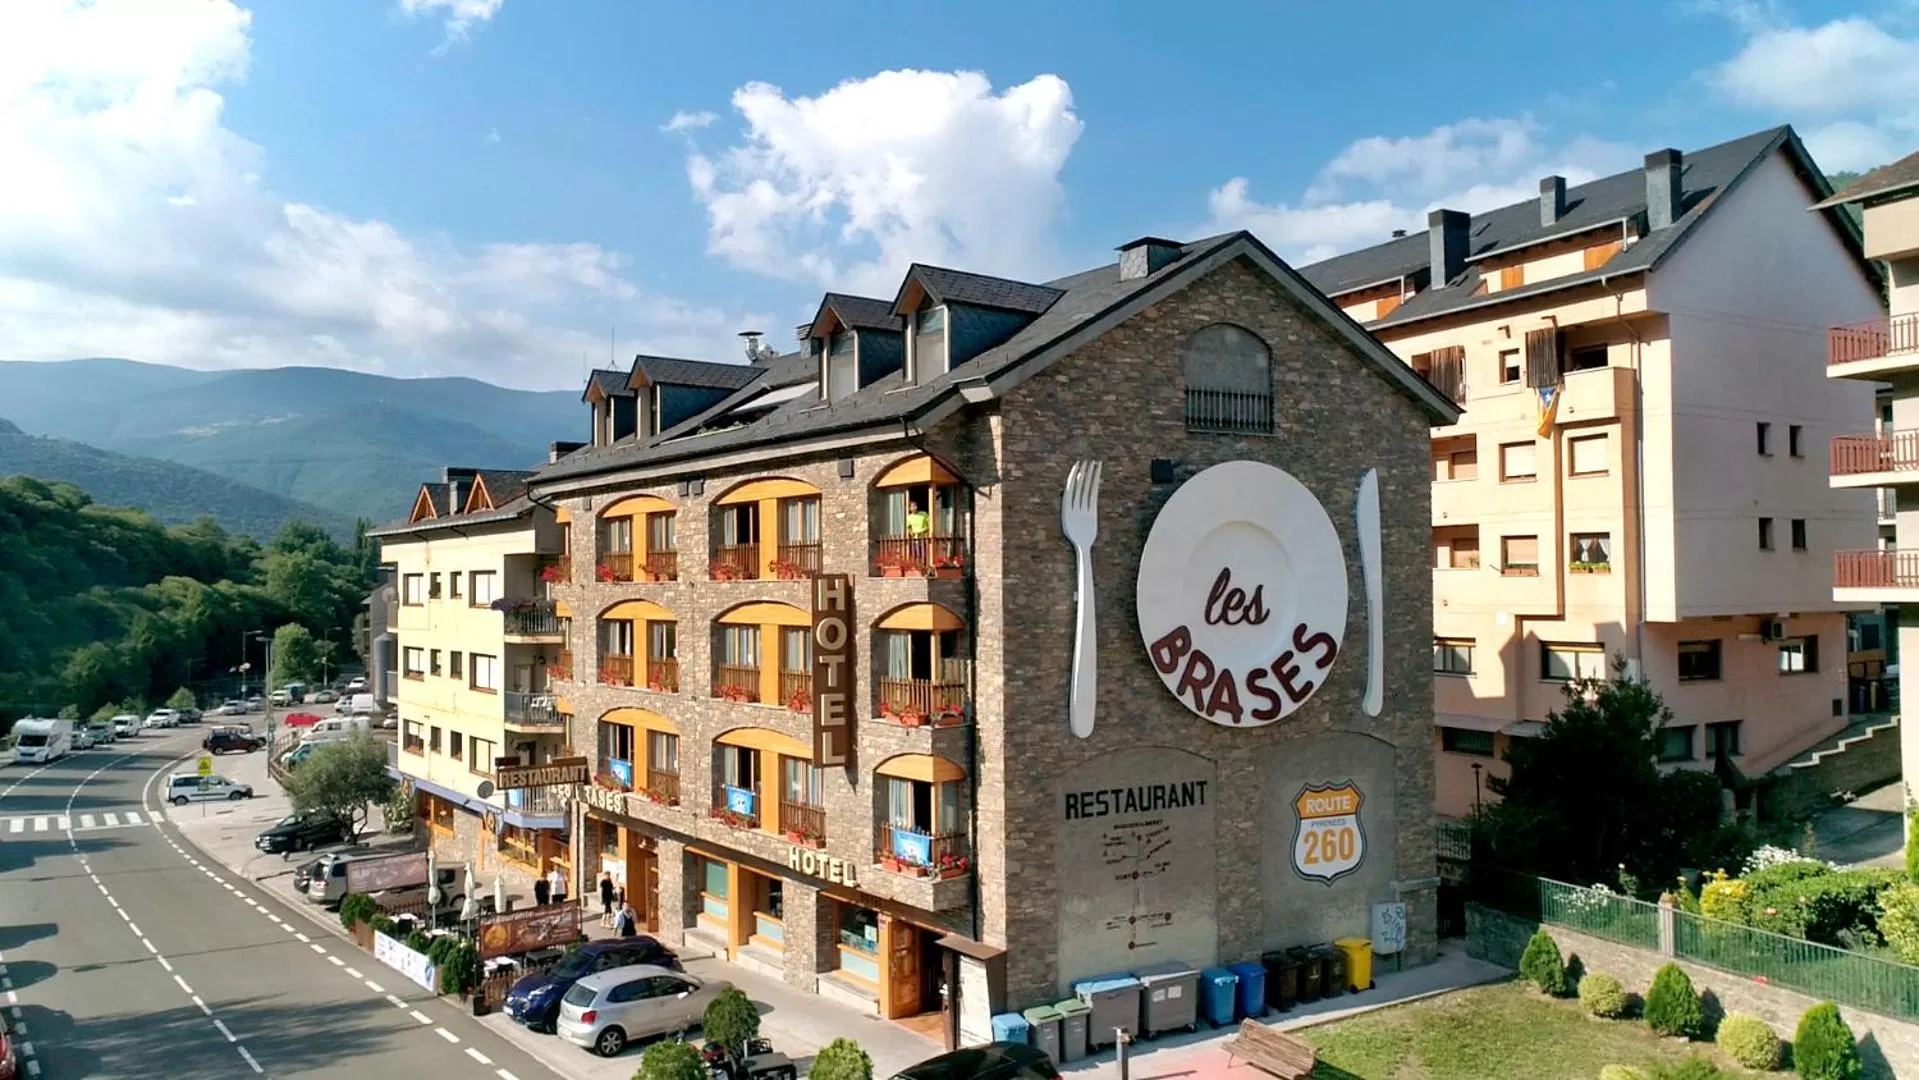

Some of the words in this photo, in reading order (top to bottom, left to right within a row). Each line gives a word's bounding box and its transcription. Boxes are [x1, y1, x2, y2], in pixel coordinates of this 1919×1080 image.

[1204, 567, 1270, 625] les
[815, 578, 847, 765] HOTEL
[1150, 623, 1338, 724] BRASES
[499, 764, 587, 789] RESTAURANT
[1065, 780, 1208, 820] RESTAURANT
[1305, 795, 1351, 815] ROUTE
[788, 845, 857, 888] HOTEL
[1302, 827, 1354, 865] 260
